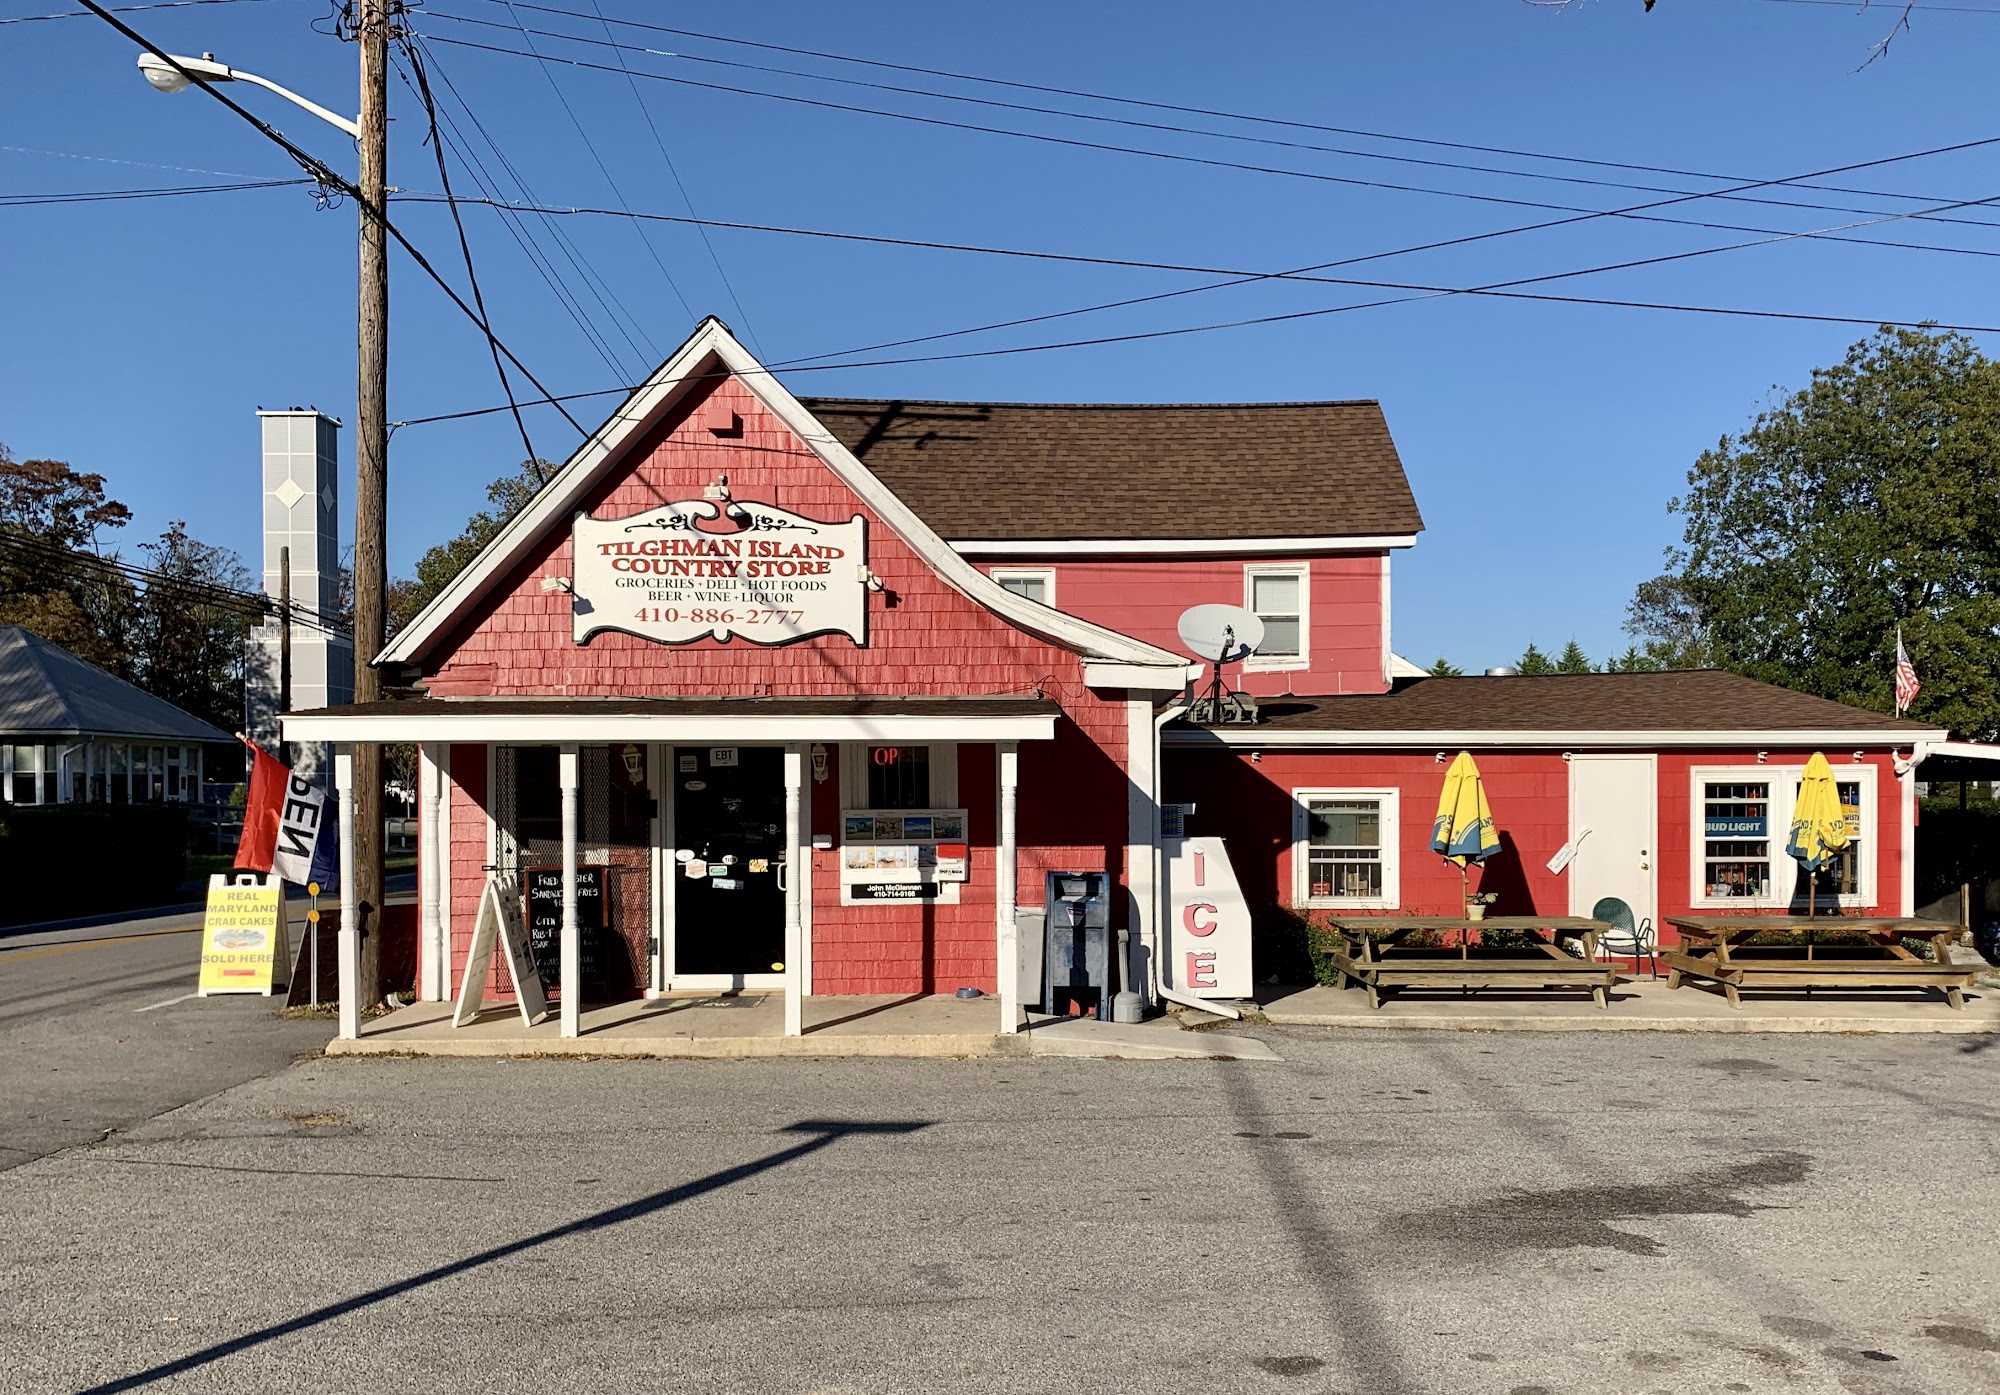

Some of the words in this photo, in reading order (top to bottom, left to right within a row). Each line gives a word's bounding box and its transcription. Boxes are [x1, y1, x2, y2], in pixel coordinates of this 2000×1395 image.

[597, 539, 742, 556] TILGHMAN
[749, 540, 845, 560] ISLAND
[611, 558, 742, 577] COUNTRY
[746, 560, 832, 577] STORE
[615, 577, 694, 589] GROCERIES
[706, 579, 738, 590] DELI
[748, 580, 778, 590] HOT
[781, 581, 827, 591] FOODS
[648, 591, 683, 601] BEER
[694, 591, 731, 602] WINE
[741, 592, 794, 605] LIQUOR
[634, 608, 805, 625] 410-886-2777
[715, 751, 734, 760] EBT
[1705, 822, 1728, 831] BUD
[1728, 822, 1761, 831] LIGHT
[867, 884, 884, 892] John
[227, 892, 260, 901] REAL
[207, 904, 278, 914] MARYLAND
[207, 917, 240, 926] CRAB
[241, 917, 275, 926] CAKES
[1183, 846, 1218, 988] ICE
[202, 954, 236, 964] SOLD
[240, 954, 274, 964] HERE
